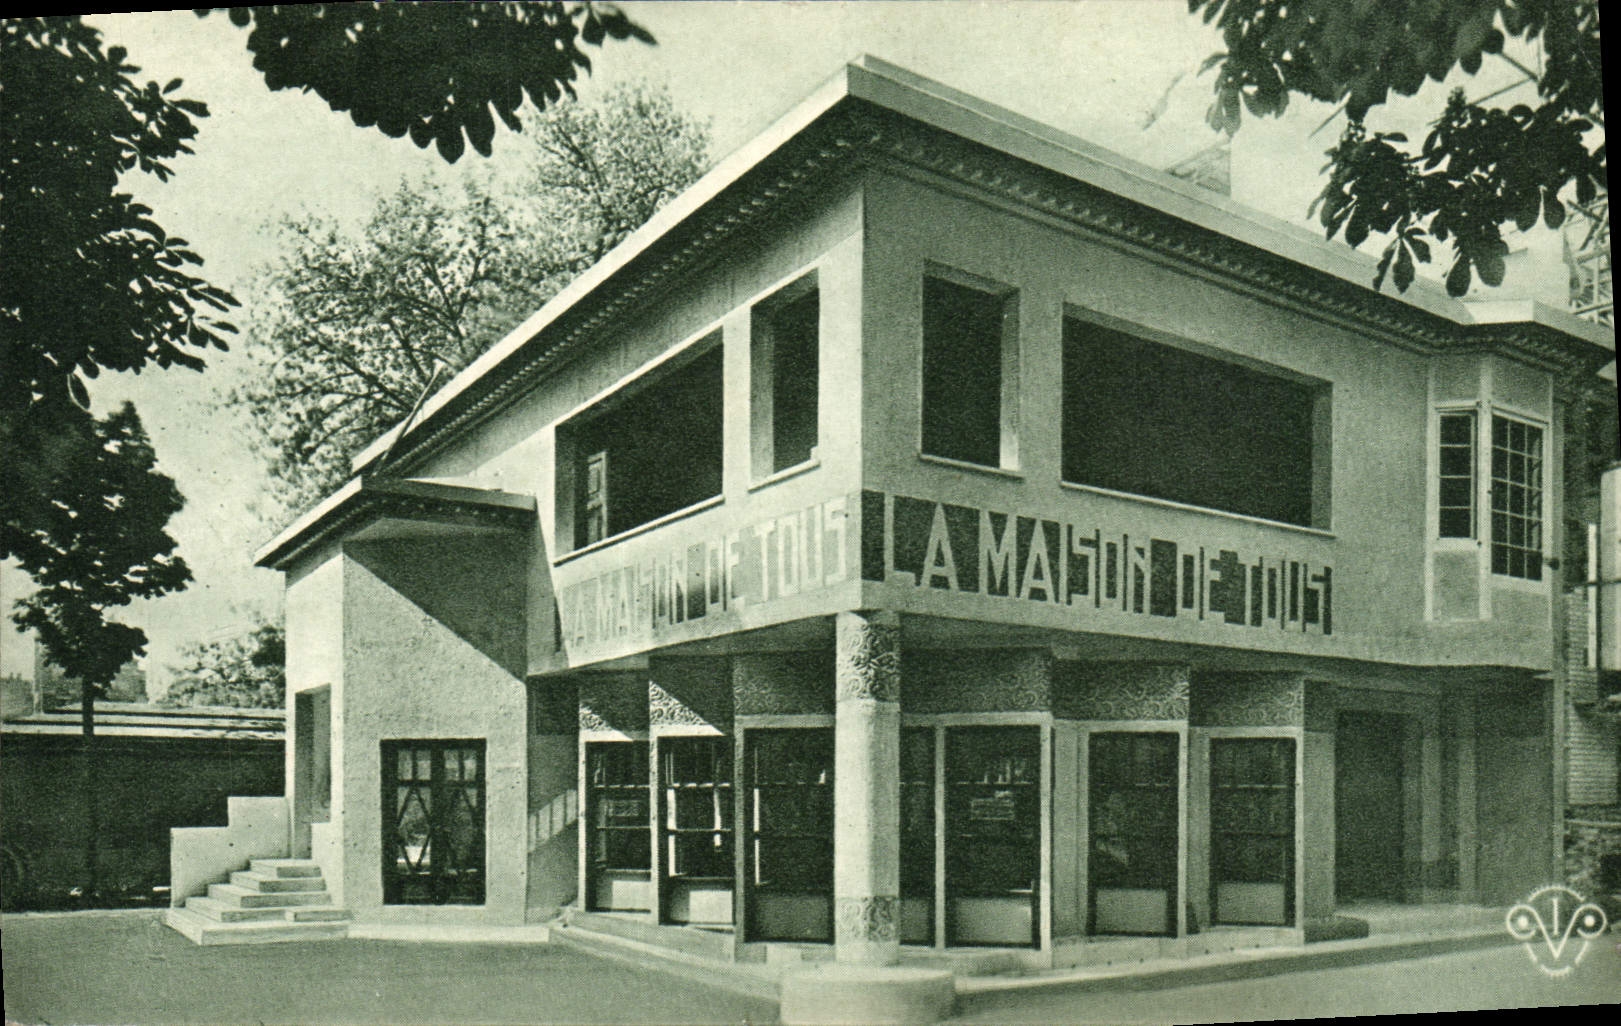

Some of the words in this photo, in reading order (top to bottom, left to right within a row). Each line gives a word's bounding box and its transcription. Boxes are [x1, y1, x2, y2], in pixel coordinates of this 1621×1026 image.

[596, 552, 688, 643] MAISON
[704, 531, 745, 617] DE
[752, 496, 847, 603] TOUS
[884, 491, 960, 591] LA
[979, 508, 1151, 616] MAISON
[1176, 541, 1226, 622] DE
[1237, 549, 1325, 634] TOUS
